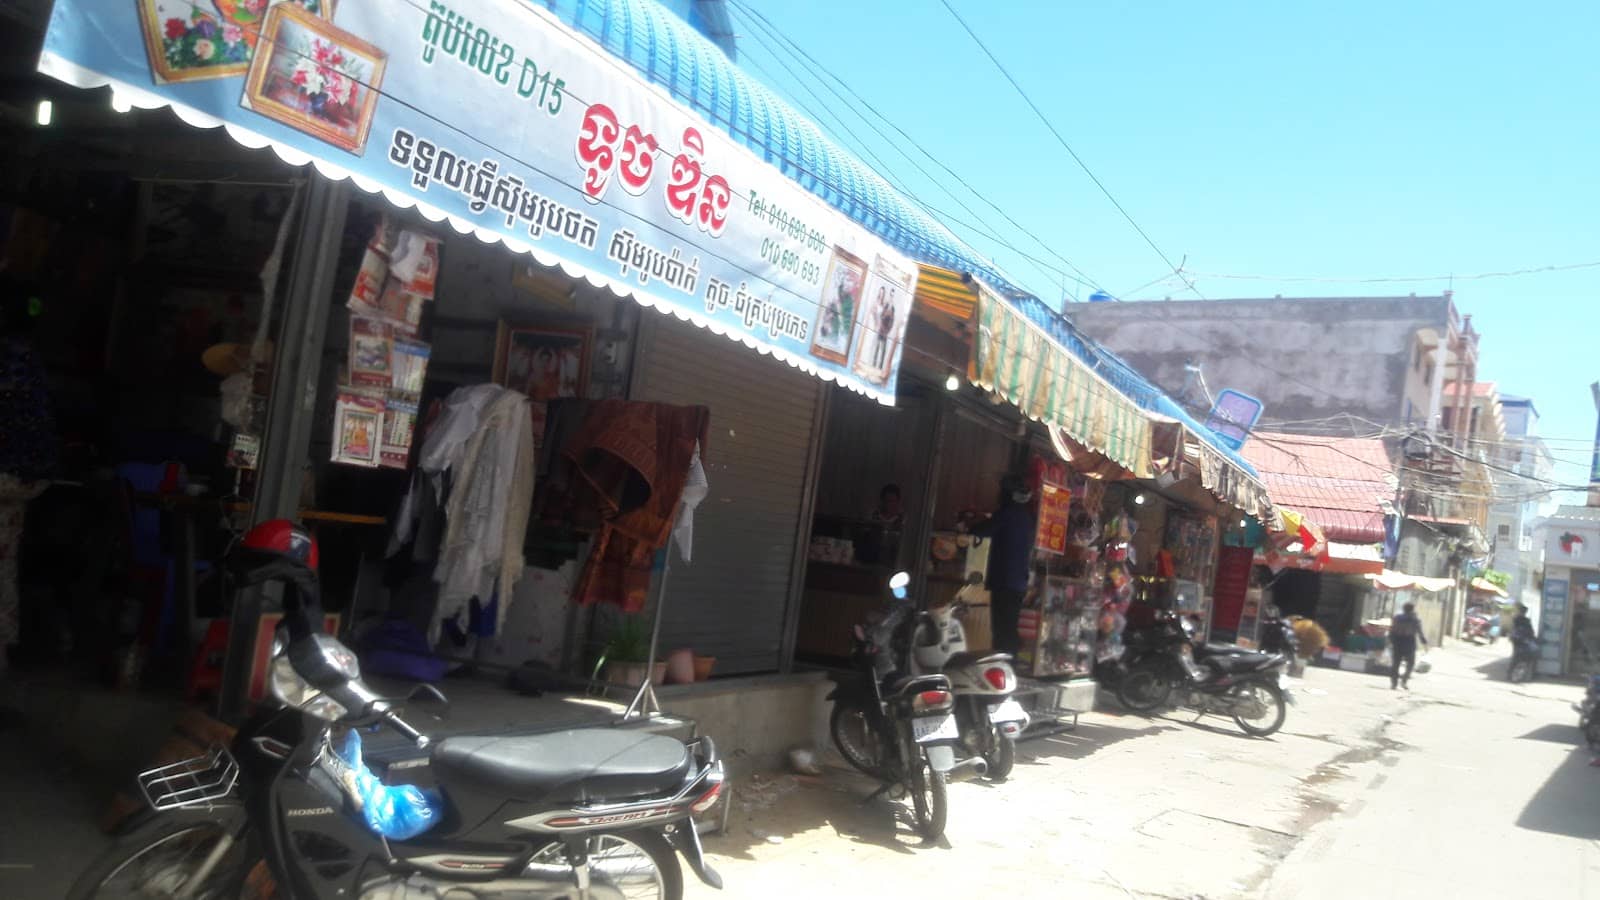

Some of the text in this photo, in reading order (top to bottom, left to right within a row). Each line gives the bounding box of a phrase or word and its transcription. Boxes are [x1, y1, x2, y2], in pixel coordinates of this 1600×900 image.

[422, 1, 566, 115] តូបលេខ D15
[578, 103, 731, 230] ទូច ឌិន
[769, 204, 788, 232] 010
[761, 237, 819, 286] 010 690 693
[288, 806, 334, 816] HONDA
